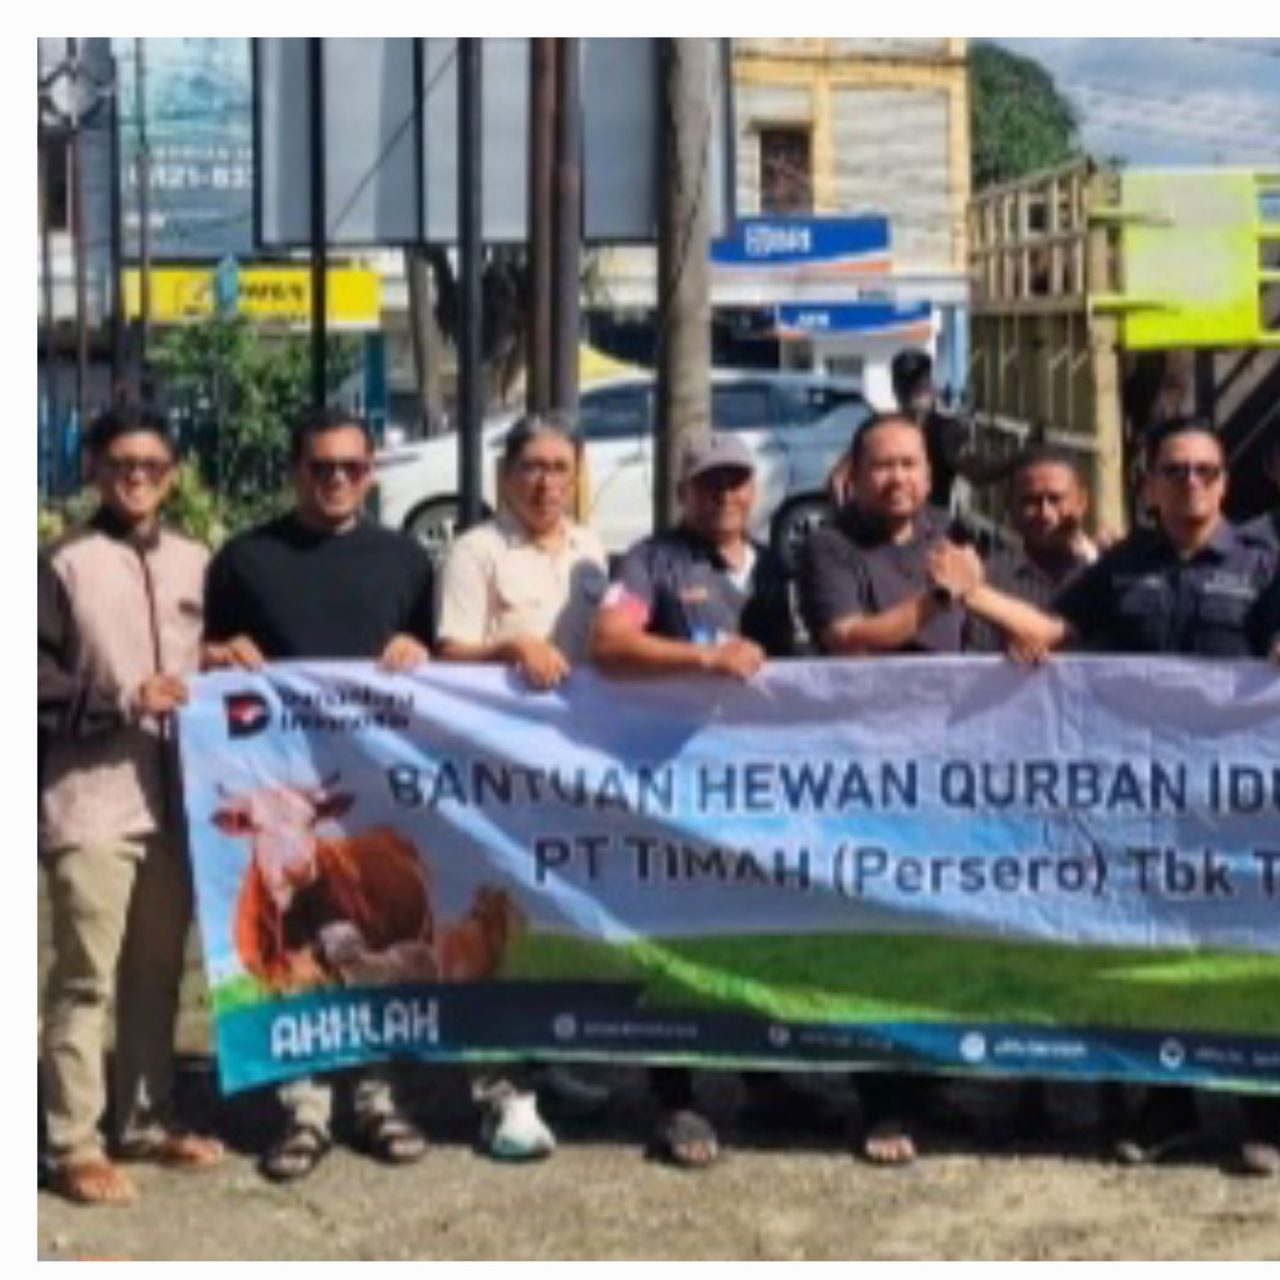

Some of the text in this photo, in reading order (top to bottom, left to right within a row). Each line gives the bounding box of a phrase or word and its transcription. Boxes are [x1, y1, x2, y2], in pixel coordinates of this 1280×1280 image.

[388, 761, 674, 816] BANTUAN
[698, 761, 918, 813] HEWAN
[938, 761, 1187, 812] QURBAN
[534, 836, 609, 887] PT
[625, 836, 811, 889] TIMAH
[832, 840, 1108, 898] (Persero)
[1126, 845, 1233, 896] Tbk
